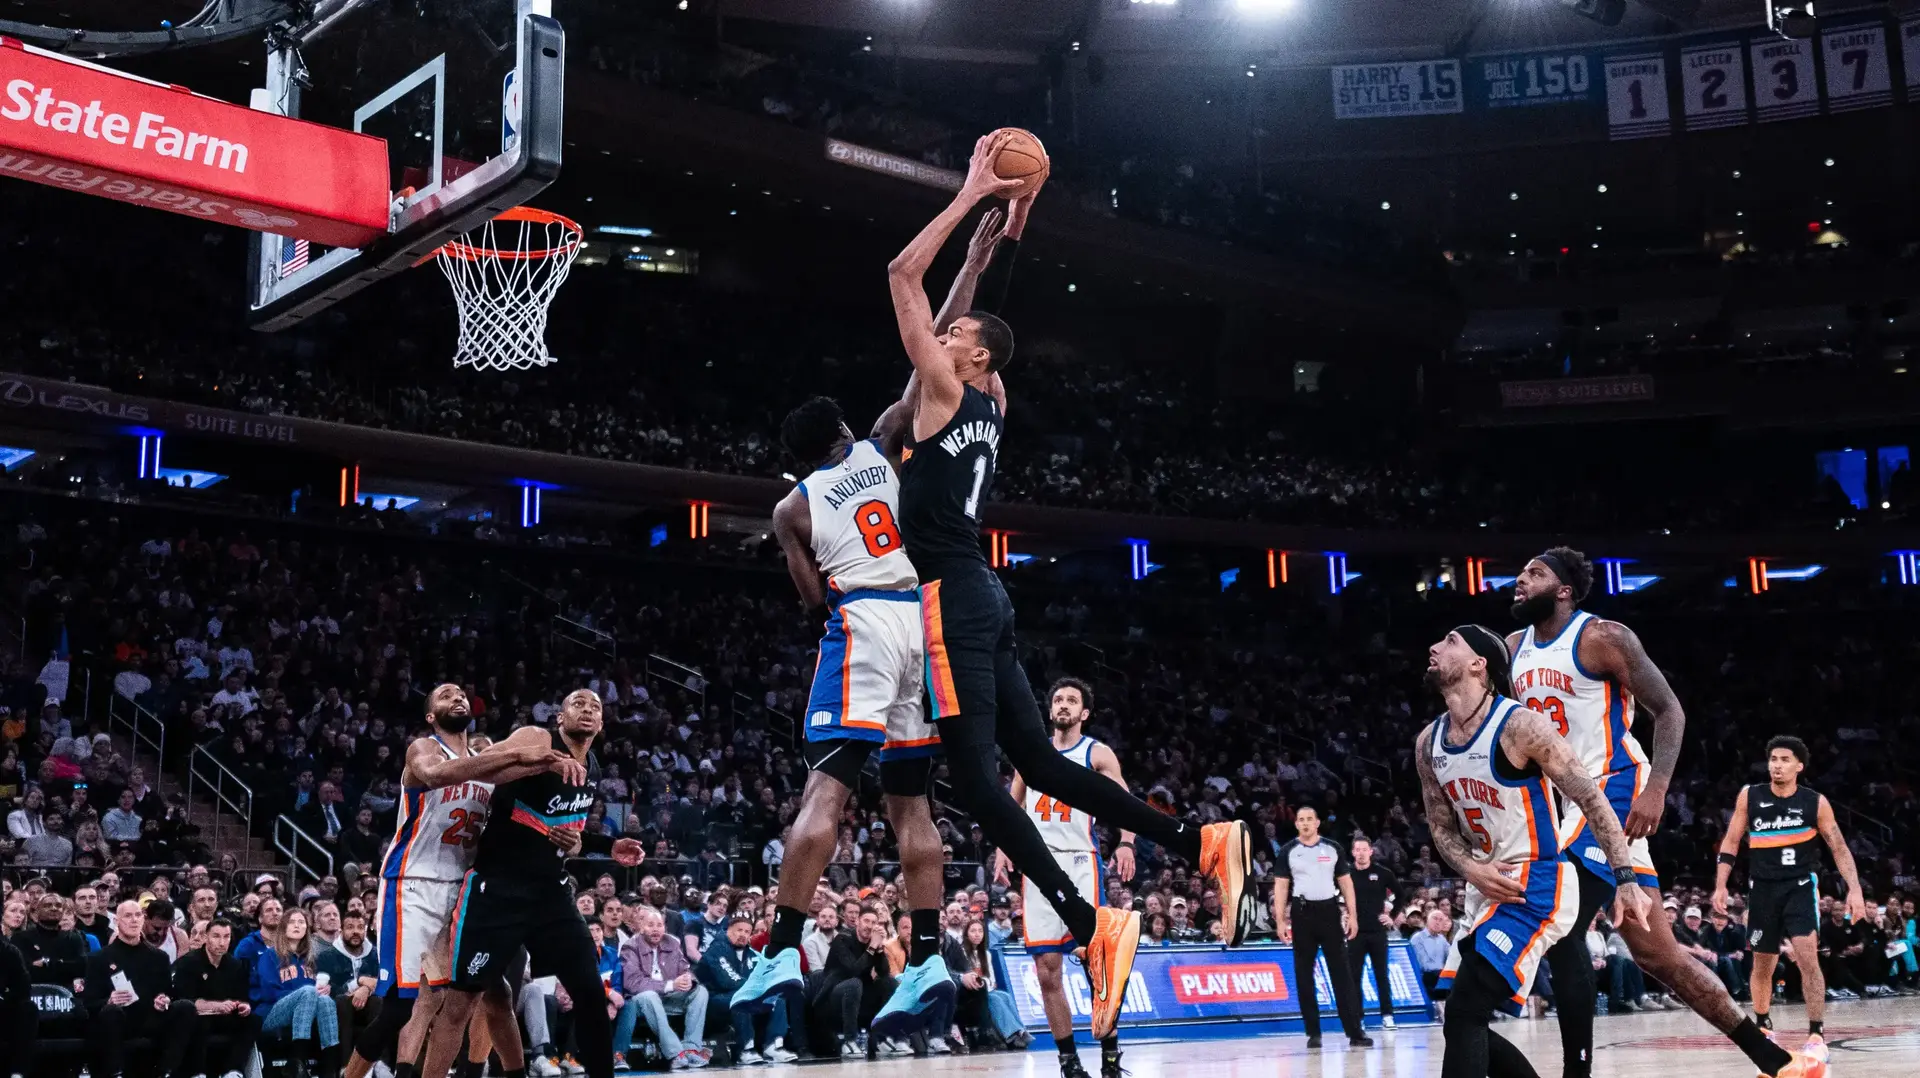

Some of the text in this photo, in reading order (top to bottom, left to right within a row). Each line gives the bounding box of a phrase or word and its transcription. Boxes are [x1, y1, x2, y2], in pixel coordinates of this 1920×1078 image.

[1342, 66, 1401, 86] HARRY
[1418, 63, 1457, 101] 15
[1484, 60, 1520, 80] BILLY
[1524, 55, 1589, 96] 150
[1771, 60, 1799, 100] 3
[1842, 50, 1868, 90] 7
[1339, 84, 1410, 105] STYLES
[1488, 79, 1520, 99] JOEL
[1628, 79, 1647, 118] 1
[1701, 69, 1727, 108] 2
[854, 150, 916, 176] HYUNDAI
[1557, 384, 1600, 398] SUITE
[1604, 381, 1647, 397] LEVEL
[39, 390, 298, 443] LEXUS SUITE LEVEL
[824, 465, 888, 511] ANUNOBY
[964, 454, 987, 519] 1
[854, 499, 903, 558] 8
[1514, 667, 1576, 697] NEW YORK
[441, 783, 470, 805] NEW
[546, 794, 570, 814] San
[1035, 792, 1072, 823] 44
[1458, 778, 1506, 811] YORK
[441, 807, 485, 849] 25
[1463, 807, 1493, 855] 5
[1754, 815, 1804, 831] San Antonio
[1781, 847, 1797, 865] 2
[1181, 973, 1229, 997] PLAY
[1231, 971, 1277, 994] NOW
